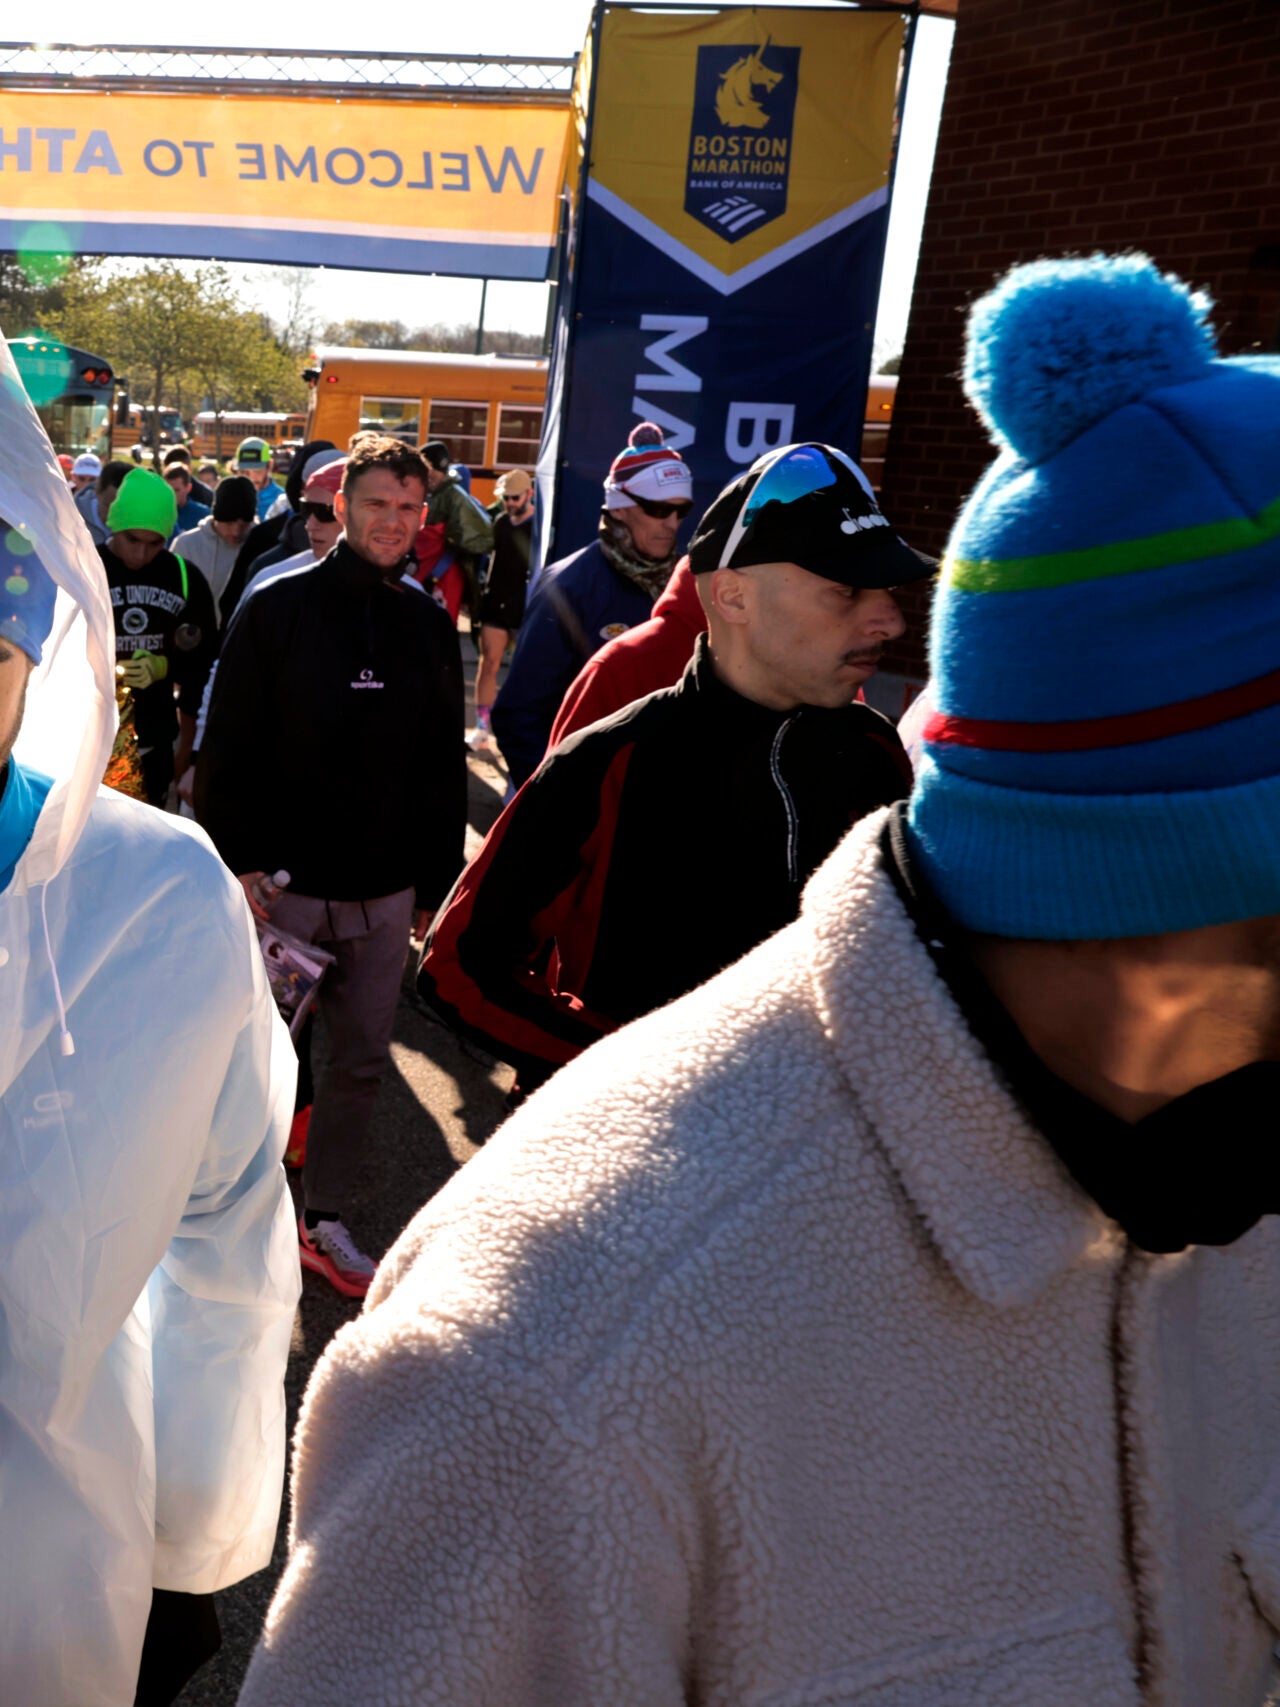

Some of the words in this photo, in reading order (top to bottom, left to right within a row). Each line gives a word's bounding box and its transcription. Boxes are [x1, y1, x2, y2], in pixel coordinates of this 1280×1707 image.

[693, 135, 787, 158] BOSTON
[691, 158, 785, 175] MARATHON
[690, 180, 719, 189] BANK
[720, 180, 735, 189] OF
[736, 181, 783, 191] AMERICA
[126, 585, 186, 617] UNIVERSITY
[351, 681, 384, 690] sportika
